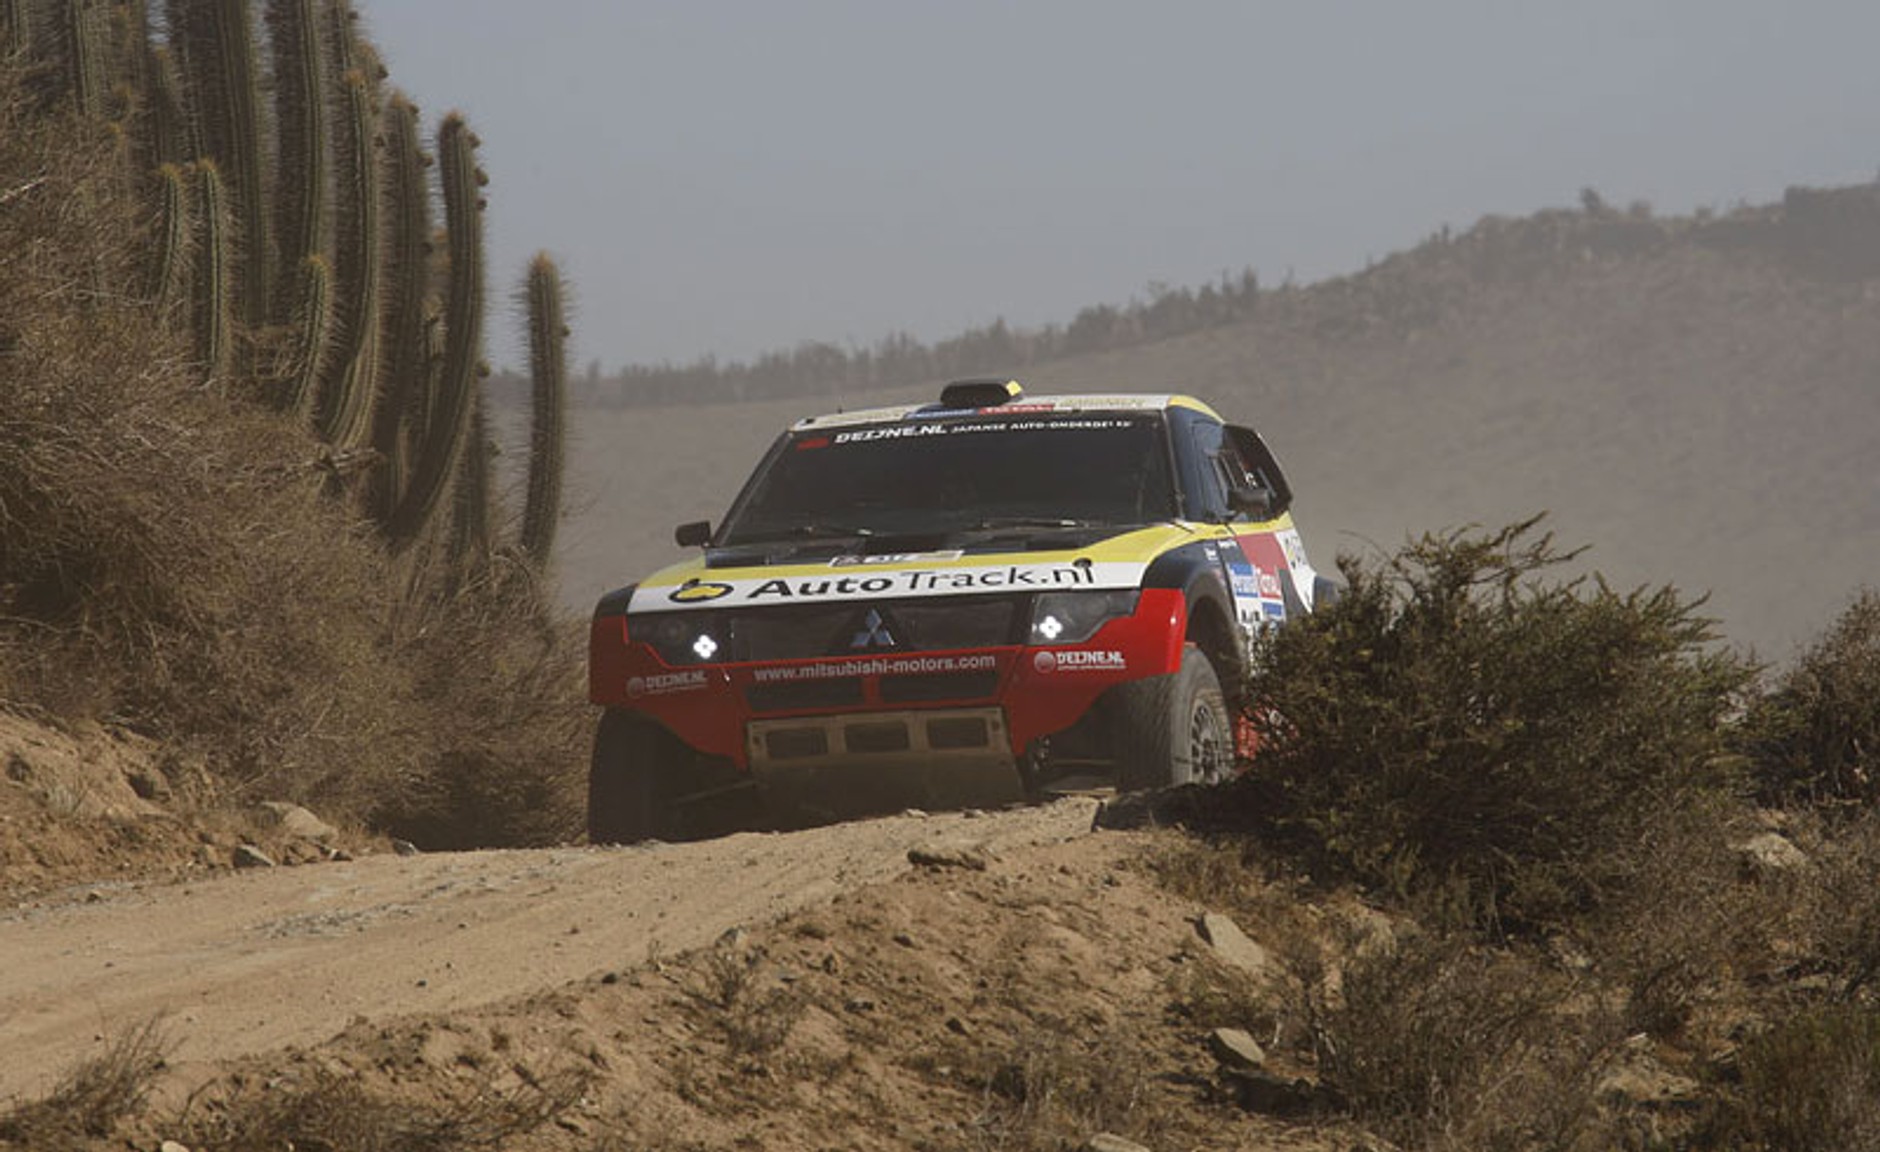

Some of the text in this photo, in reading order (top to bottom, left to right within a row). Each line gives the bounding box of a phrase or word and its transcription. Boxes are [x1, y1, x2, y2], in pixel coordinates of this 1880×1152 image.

[834, 424, 947, 444] DEIJNE.NL
[951, 422, 1006, 434] JAPANSE
[746, 565, 1095, 599] AutoTrack.nl
[753, 655, 996, 681] www.mitsubishi-motors.com
